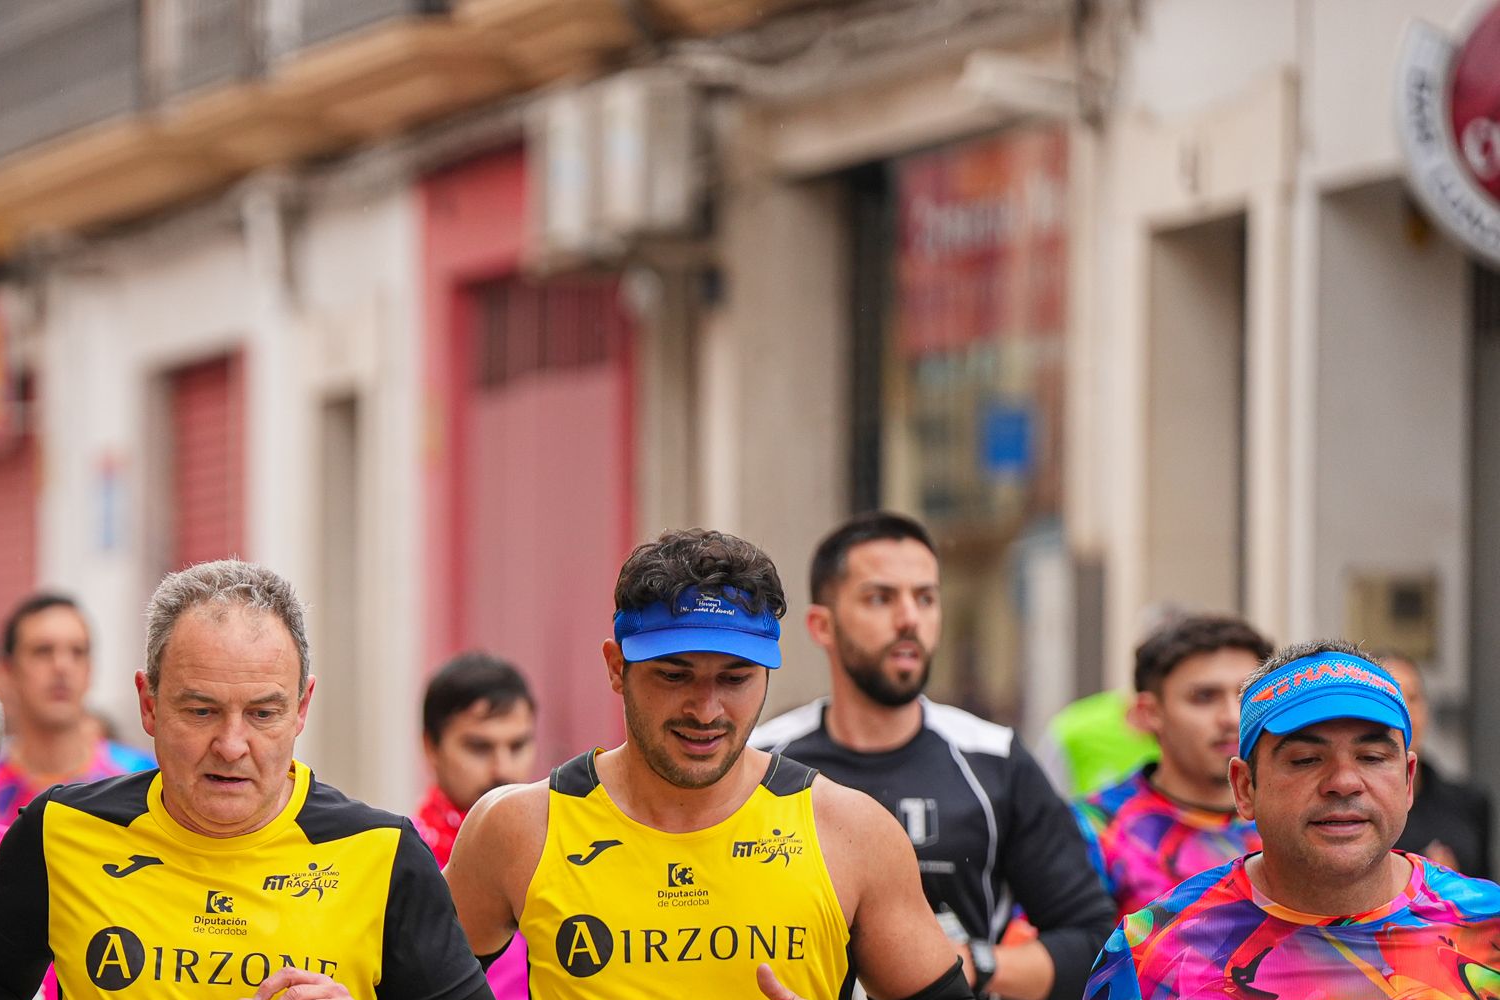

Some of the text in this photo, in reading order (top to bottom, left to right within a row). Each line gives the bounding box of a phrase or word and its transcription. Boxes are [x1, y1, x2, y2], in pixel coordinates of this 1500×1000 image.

[657, 888, 709, 899] Diputación
[657, 899, 669, 908] de
[194, 915, 248, 927] Diputación
[193, 924, 206, 934] de
[558, 916, 807, 970] AIRZONE
